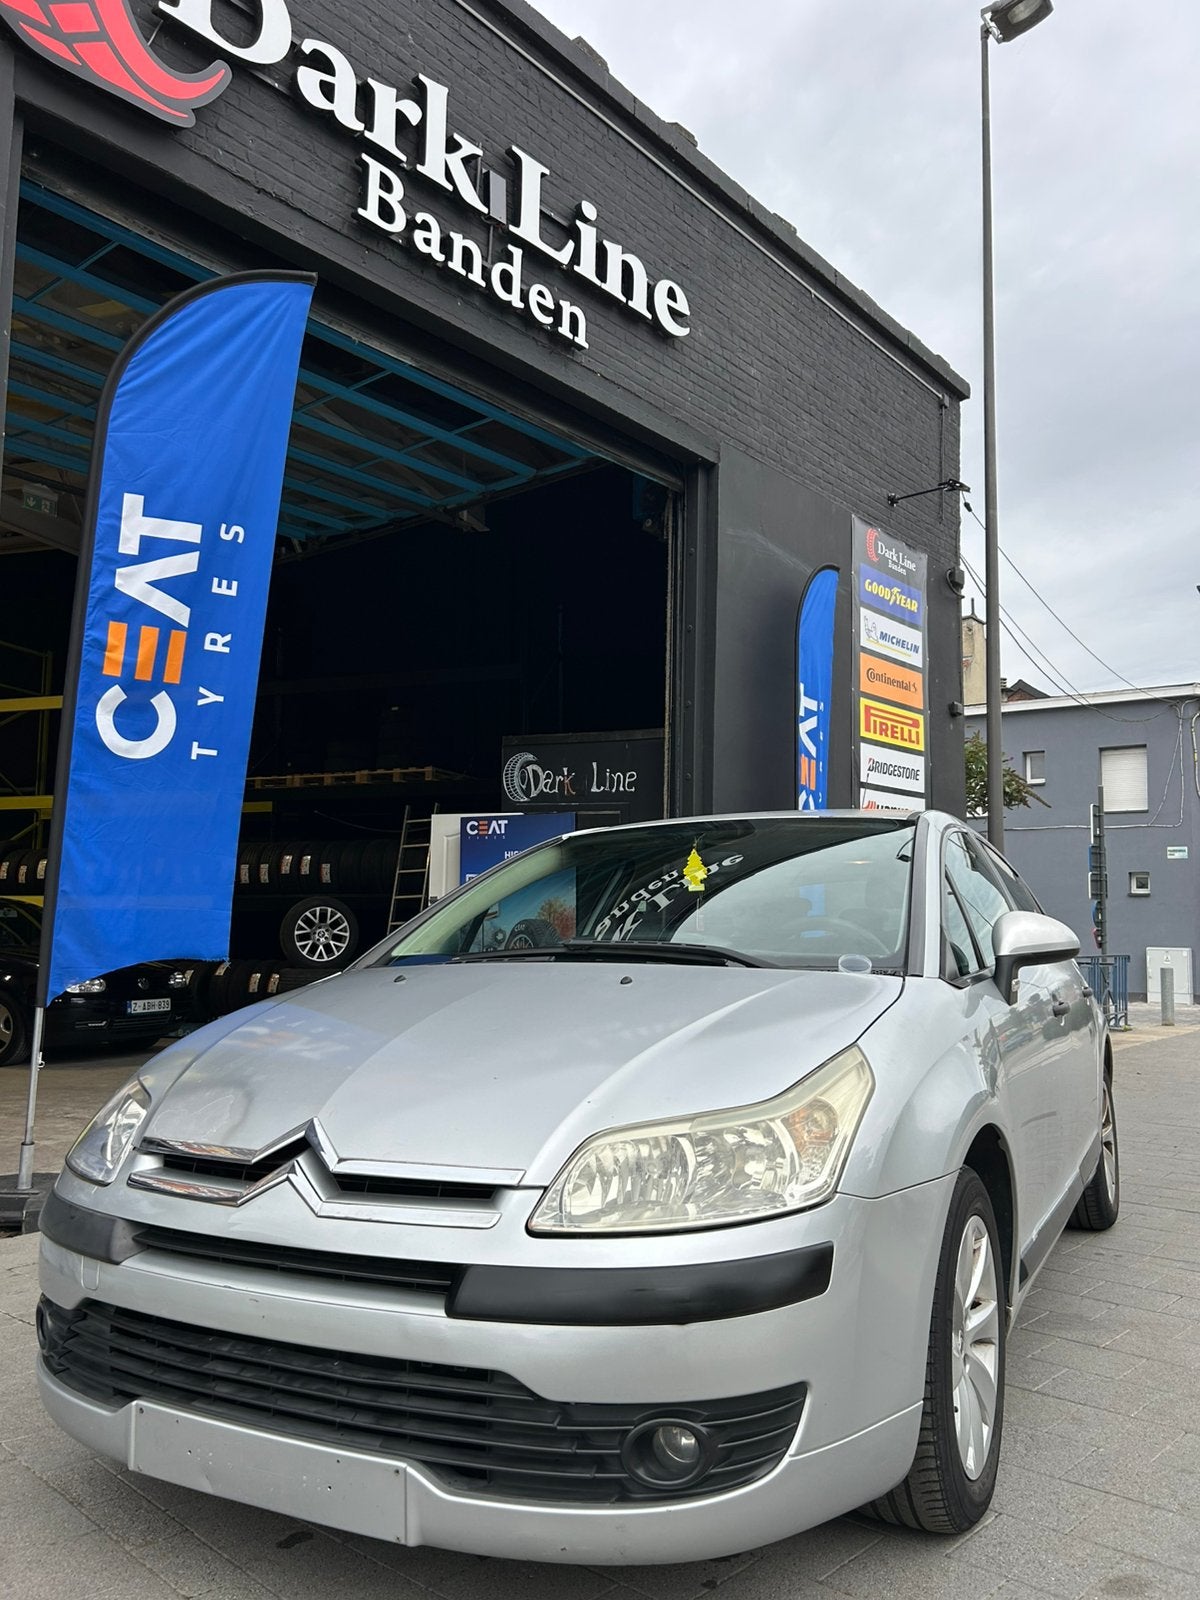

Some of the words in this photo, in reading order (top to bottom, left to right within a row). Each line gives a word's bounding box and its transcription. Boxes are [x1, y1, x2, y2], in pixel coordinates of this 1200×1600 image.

[357, 152, 589, 350] Banden
[508, 144, 691, 337] Line
[877, 541, 898, 563] Dark
[899, 552, 916, 572] Line
[864, 579, 919, 613] GOODYEAR
[96, 492, 202, 760] CEAT
[191, 523, 245, 760] TYRES
[879, 631, 920, 654] MICHELIN
[866, 667, 911, 692] Continental
[864, 704, 921, 745] PIRELLI
[525, 764, 576, 798] Dark
[590, 761, 638, 793] Line
[868, 757, 921, 781] BRIDGESTONE
[466, 820, 509, 835] CEAT
